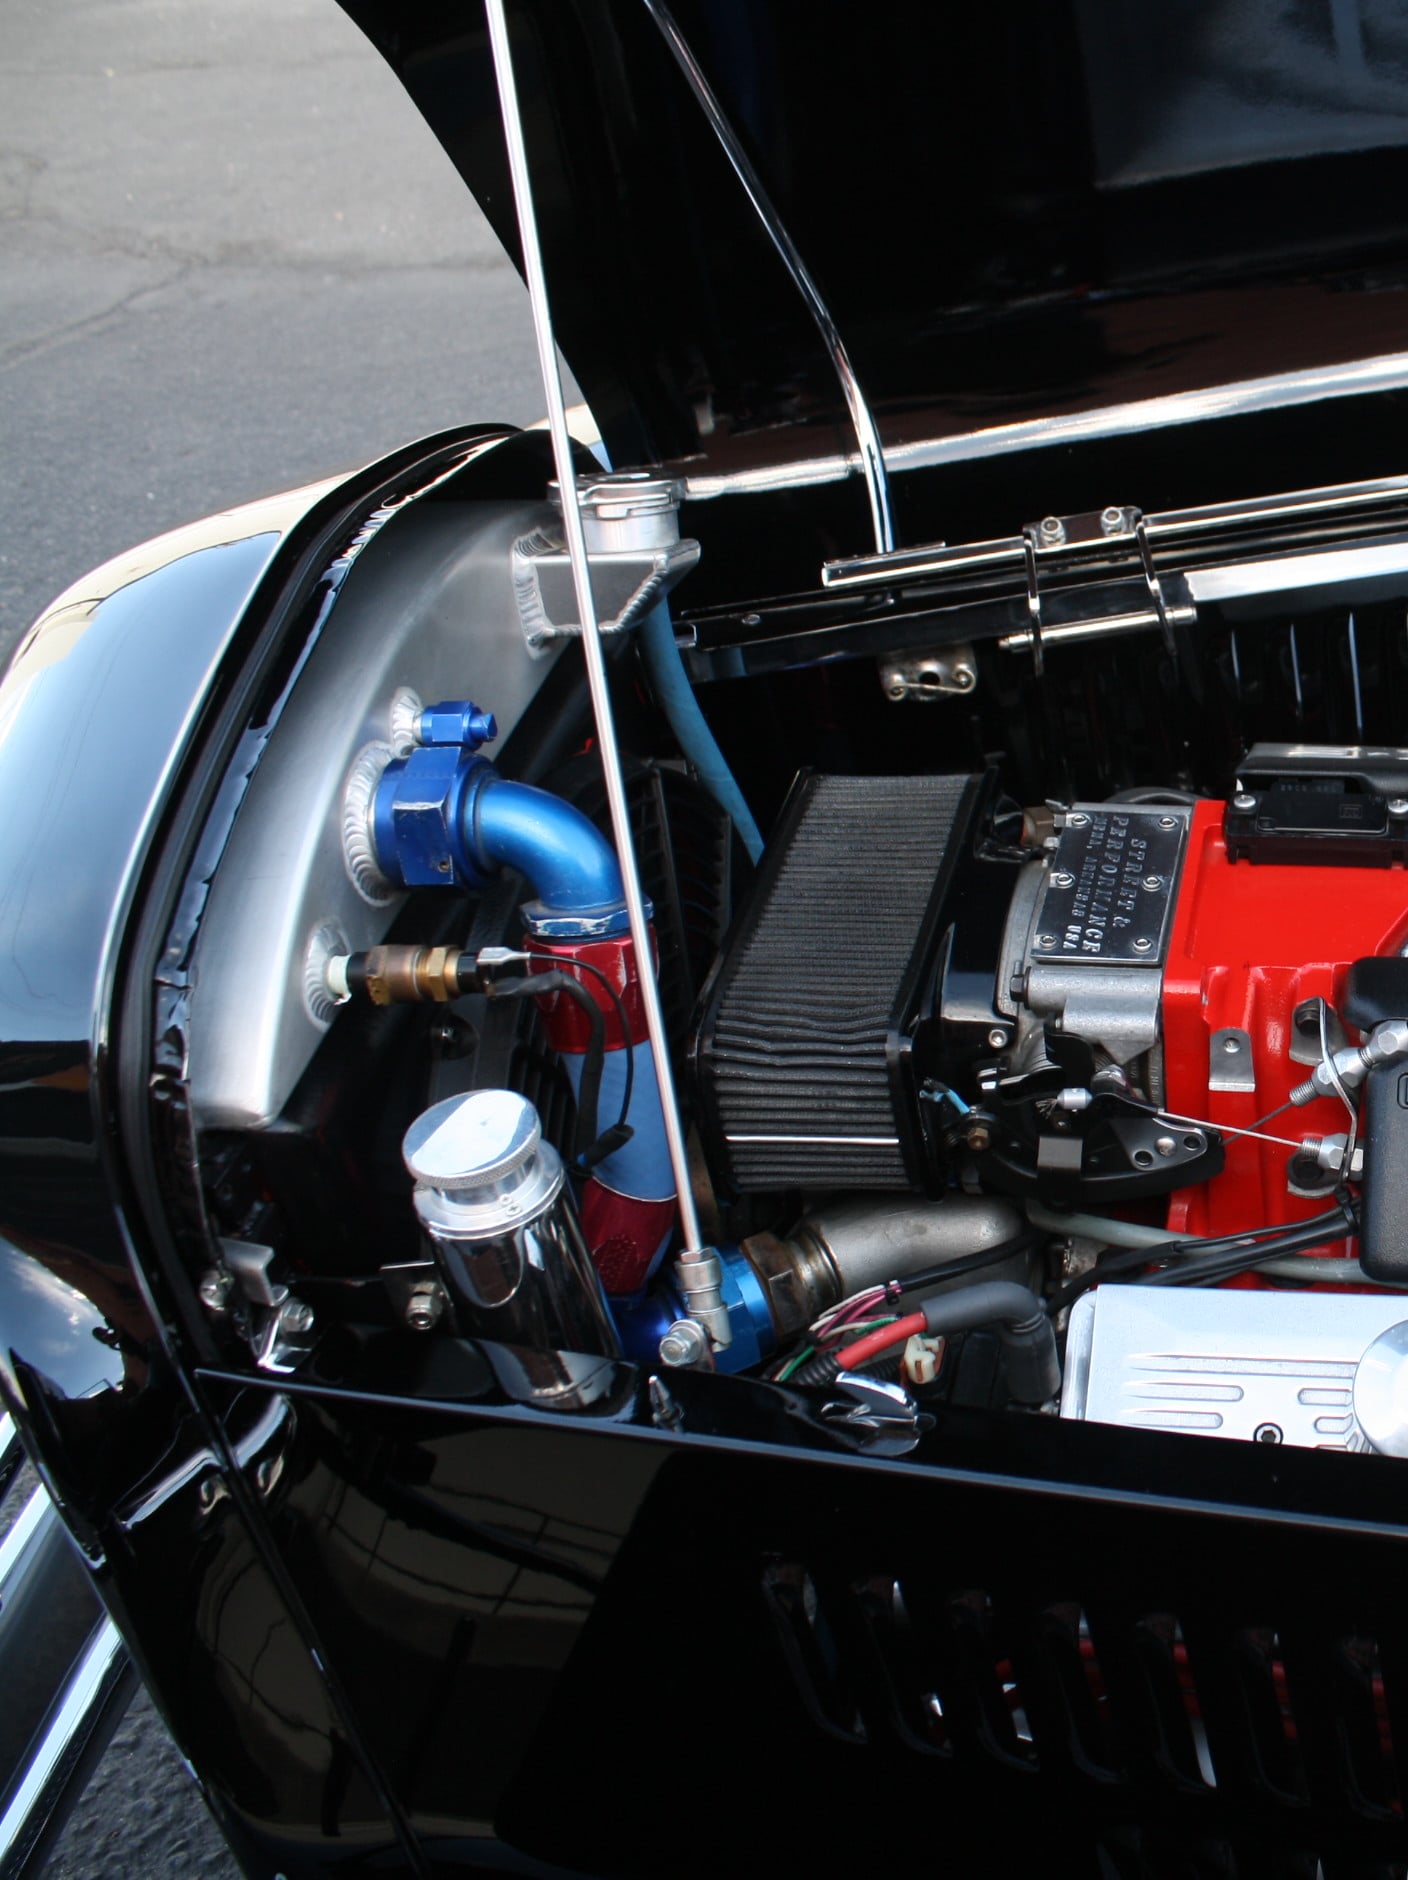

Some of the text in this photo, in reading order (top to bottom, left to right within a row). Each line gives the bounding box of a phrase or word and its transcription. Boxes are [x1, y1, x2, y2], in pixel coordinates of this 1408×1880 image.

[1082, 815, 1129, 952] PERFORMANCE
[1112, 838, 1147, 928] STREET &
[1063, 925, 1082, 949] USA
